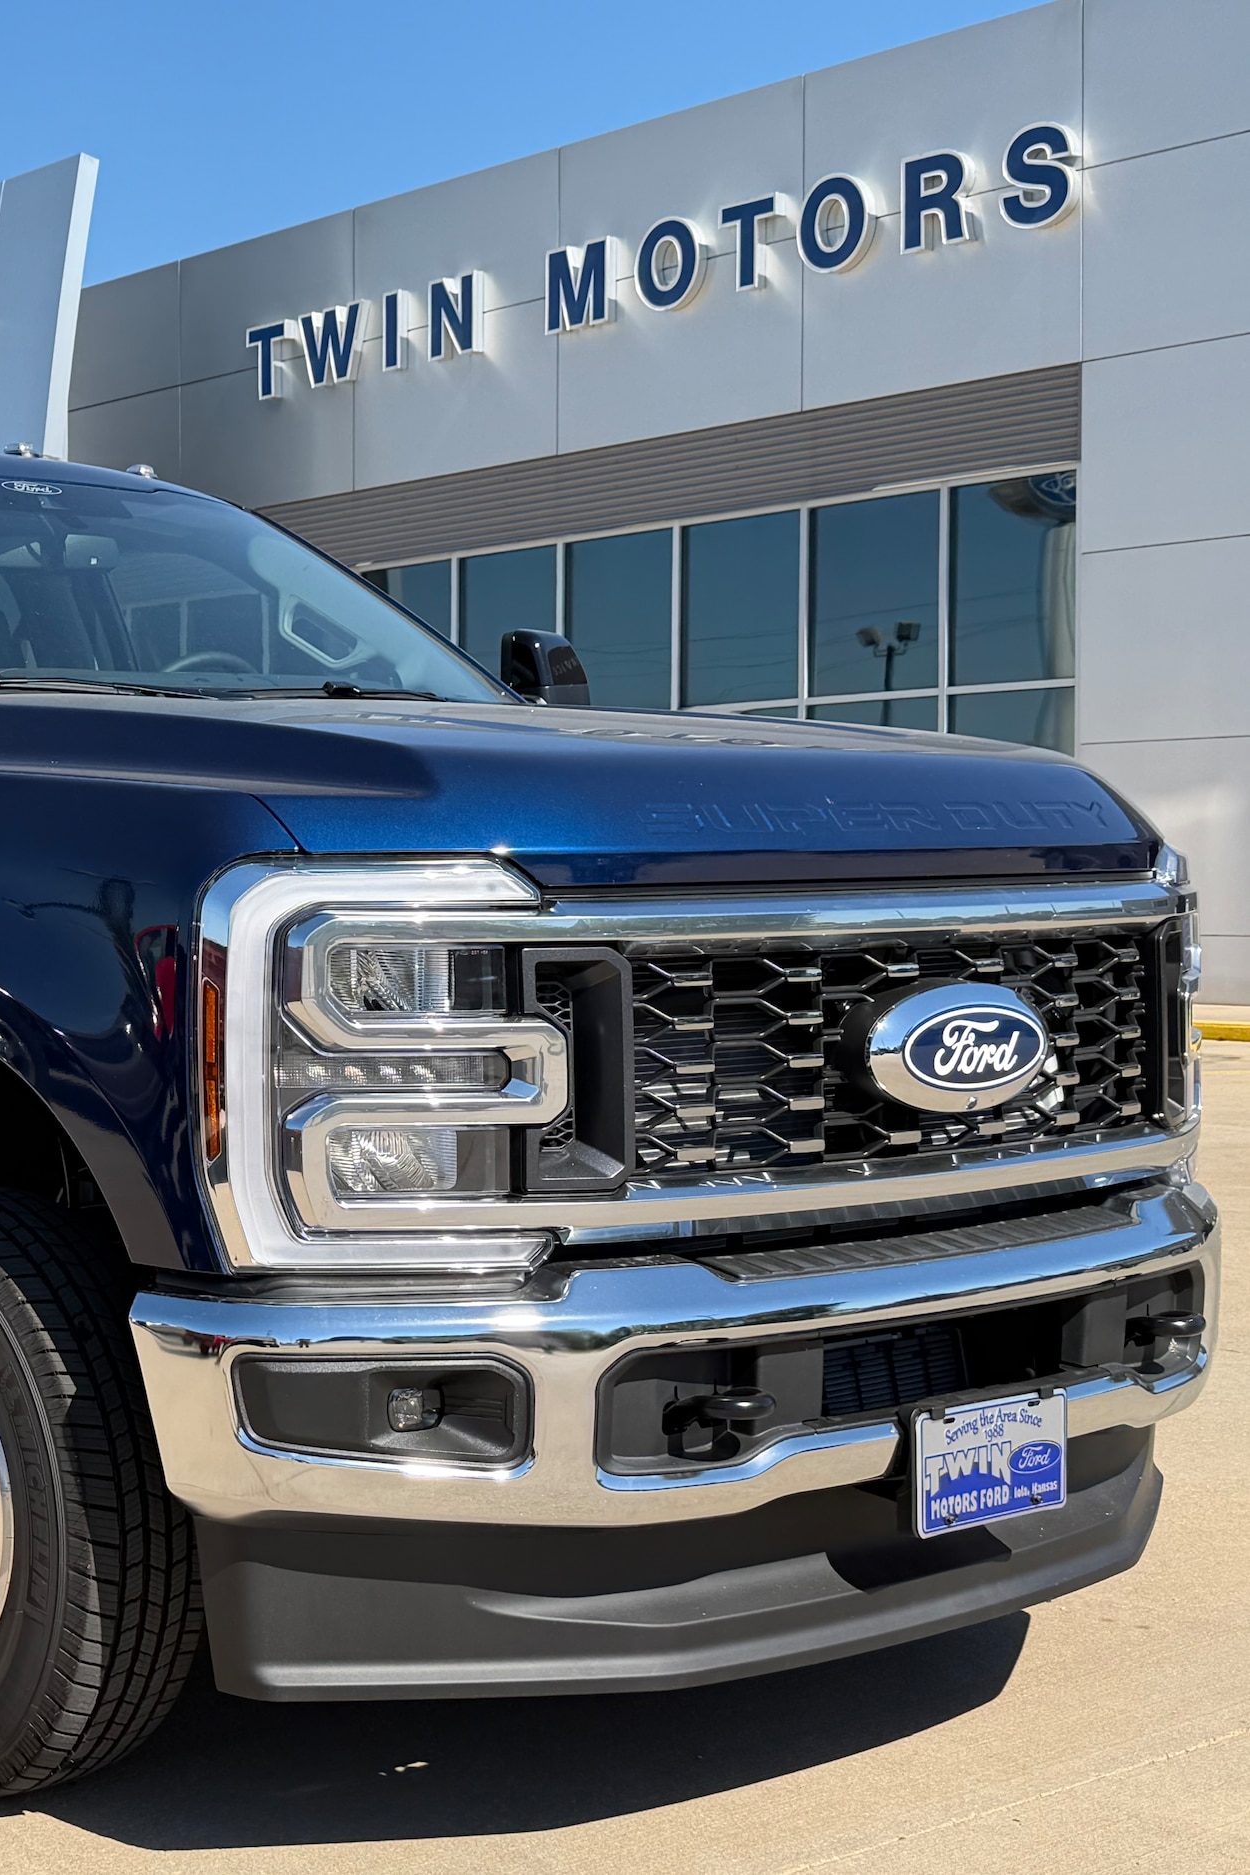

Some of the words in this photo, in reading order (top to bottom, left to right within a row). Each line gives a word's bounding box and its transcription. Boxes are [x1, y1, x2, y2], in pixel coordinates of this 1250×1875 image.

[246, 270, 484, 401] TWIN
[545, 121, 1082, 336] MOTORS
[637, 801, 943, 836] SUPER
[944, 800, 1110, 831] DUTY
[934, 1019, 1021, 1076] Ford
[945, 1419, 979, 1445] Serving
[979, 1409, 995, 1427] the
[995, 1408, 1018, 1424] Area
[1019, 1408, 1043, 1428] Since
[984, 1424, 1004, 1442] 1988
[925, 1441, 1012, 1497] TWIN
[1018, 1446, 1051, 1469] Ford
[930, 1490, 978, 1520] MOTORS
[980, 1485, 1010, 1509] FORD
[1031, 1480, 1058, 1495] Kansas
[12, 1415, 49, 1609] MICHELIN
